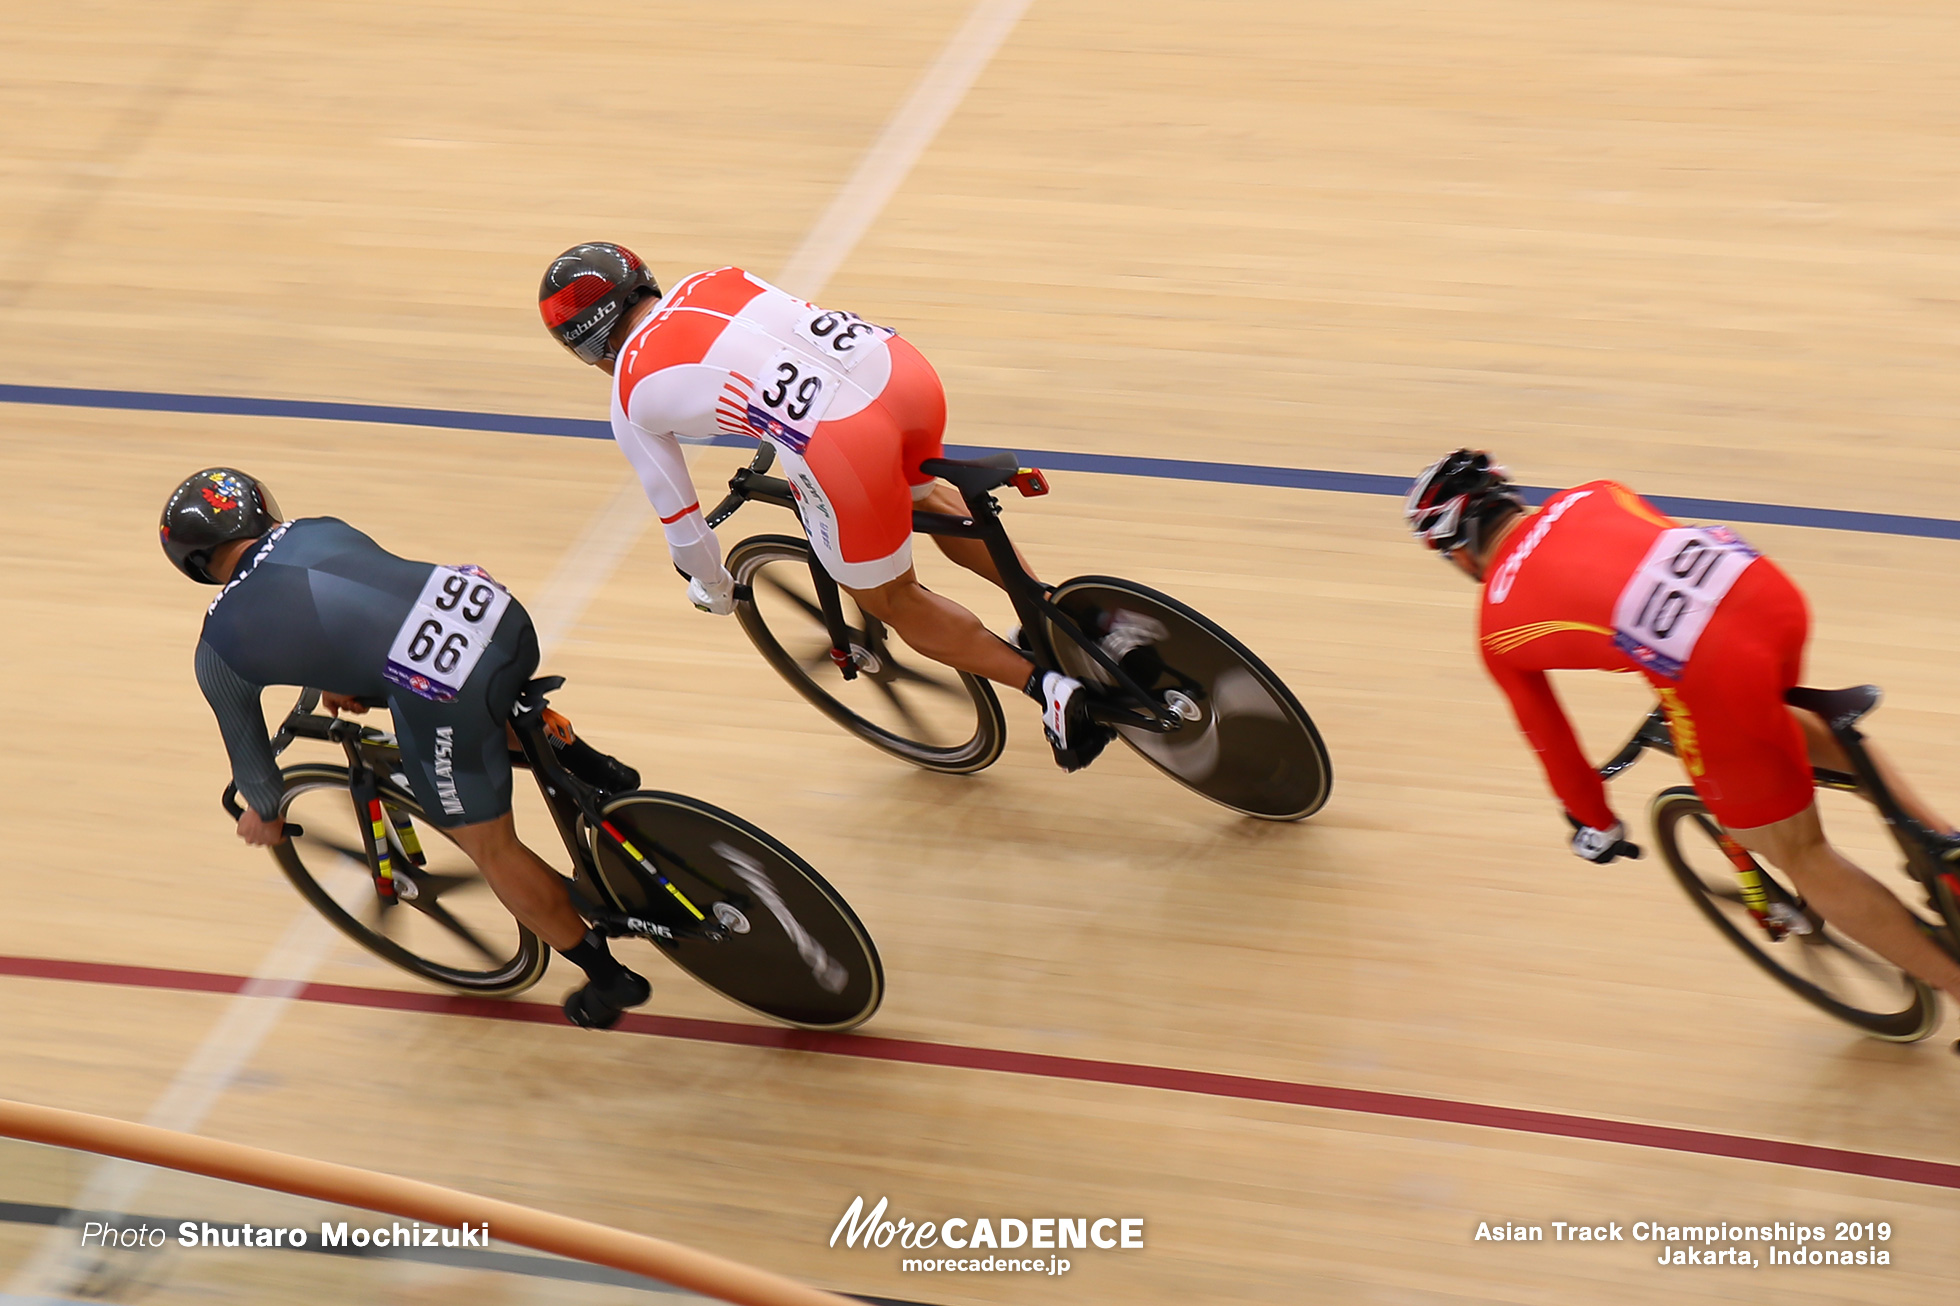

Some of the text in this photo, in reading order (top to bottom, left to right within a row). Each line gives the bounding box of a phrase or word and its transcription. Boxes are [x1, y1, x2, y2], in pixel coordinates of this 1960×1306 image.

[563, 300, 617, 343] Kabuto
[763, 362, 823, 421] 39
[407, 619, 469, 674] 66
[435, 725, 466, 816] MALAYSIA
